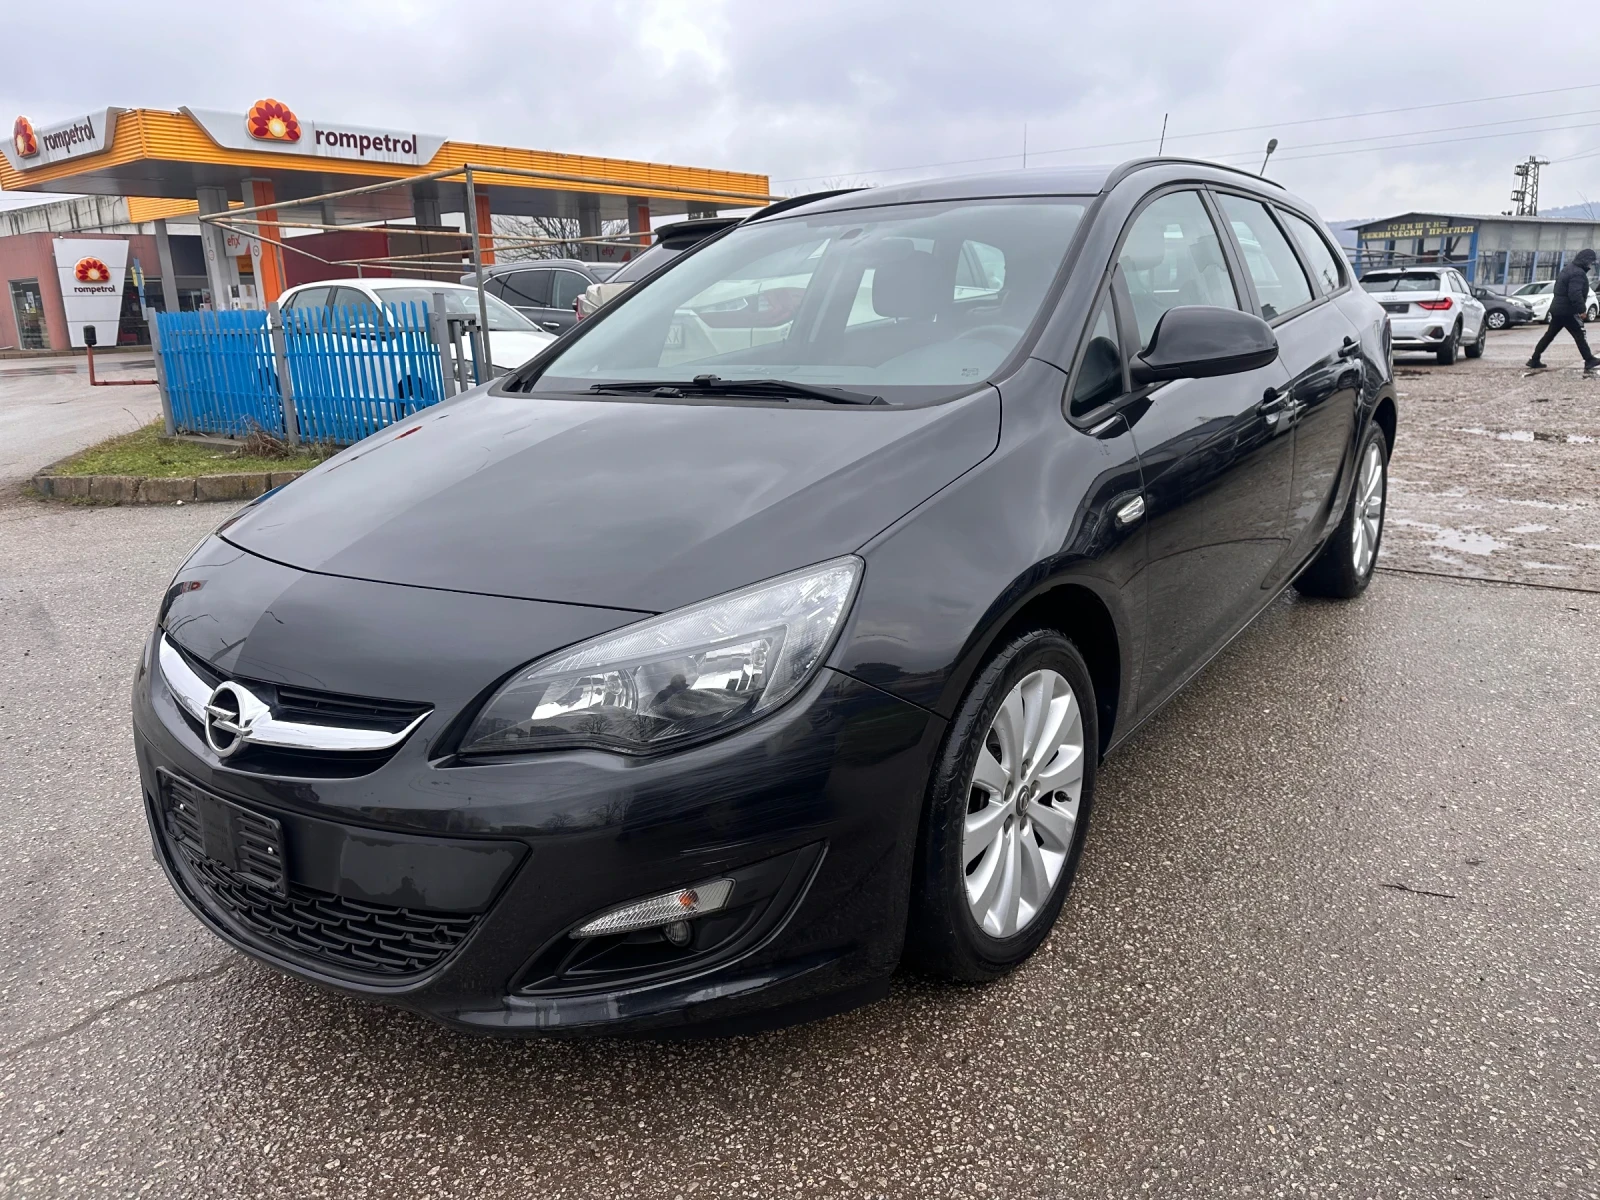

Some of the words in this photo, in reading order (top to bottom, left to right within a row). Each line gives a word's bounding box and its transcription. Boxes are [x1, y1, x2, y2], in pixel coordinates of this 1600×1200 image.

[43, 115, 95, 154] rompetrol
[315, 129, 417, 156] rompetrol
[1361, 229, 1423, 240] ТЕХНИЧЕСКИ
[1429, 225, 1474, 235] ПРЕГЛЕД
[1387, 221, 1441, 231] ГОДИШЕН
[227, 234, 241, 249] efix
[74, 284, 116, 295] rompetrol
